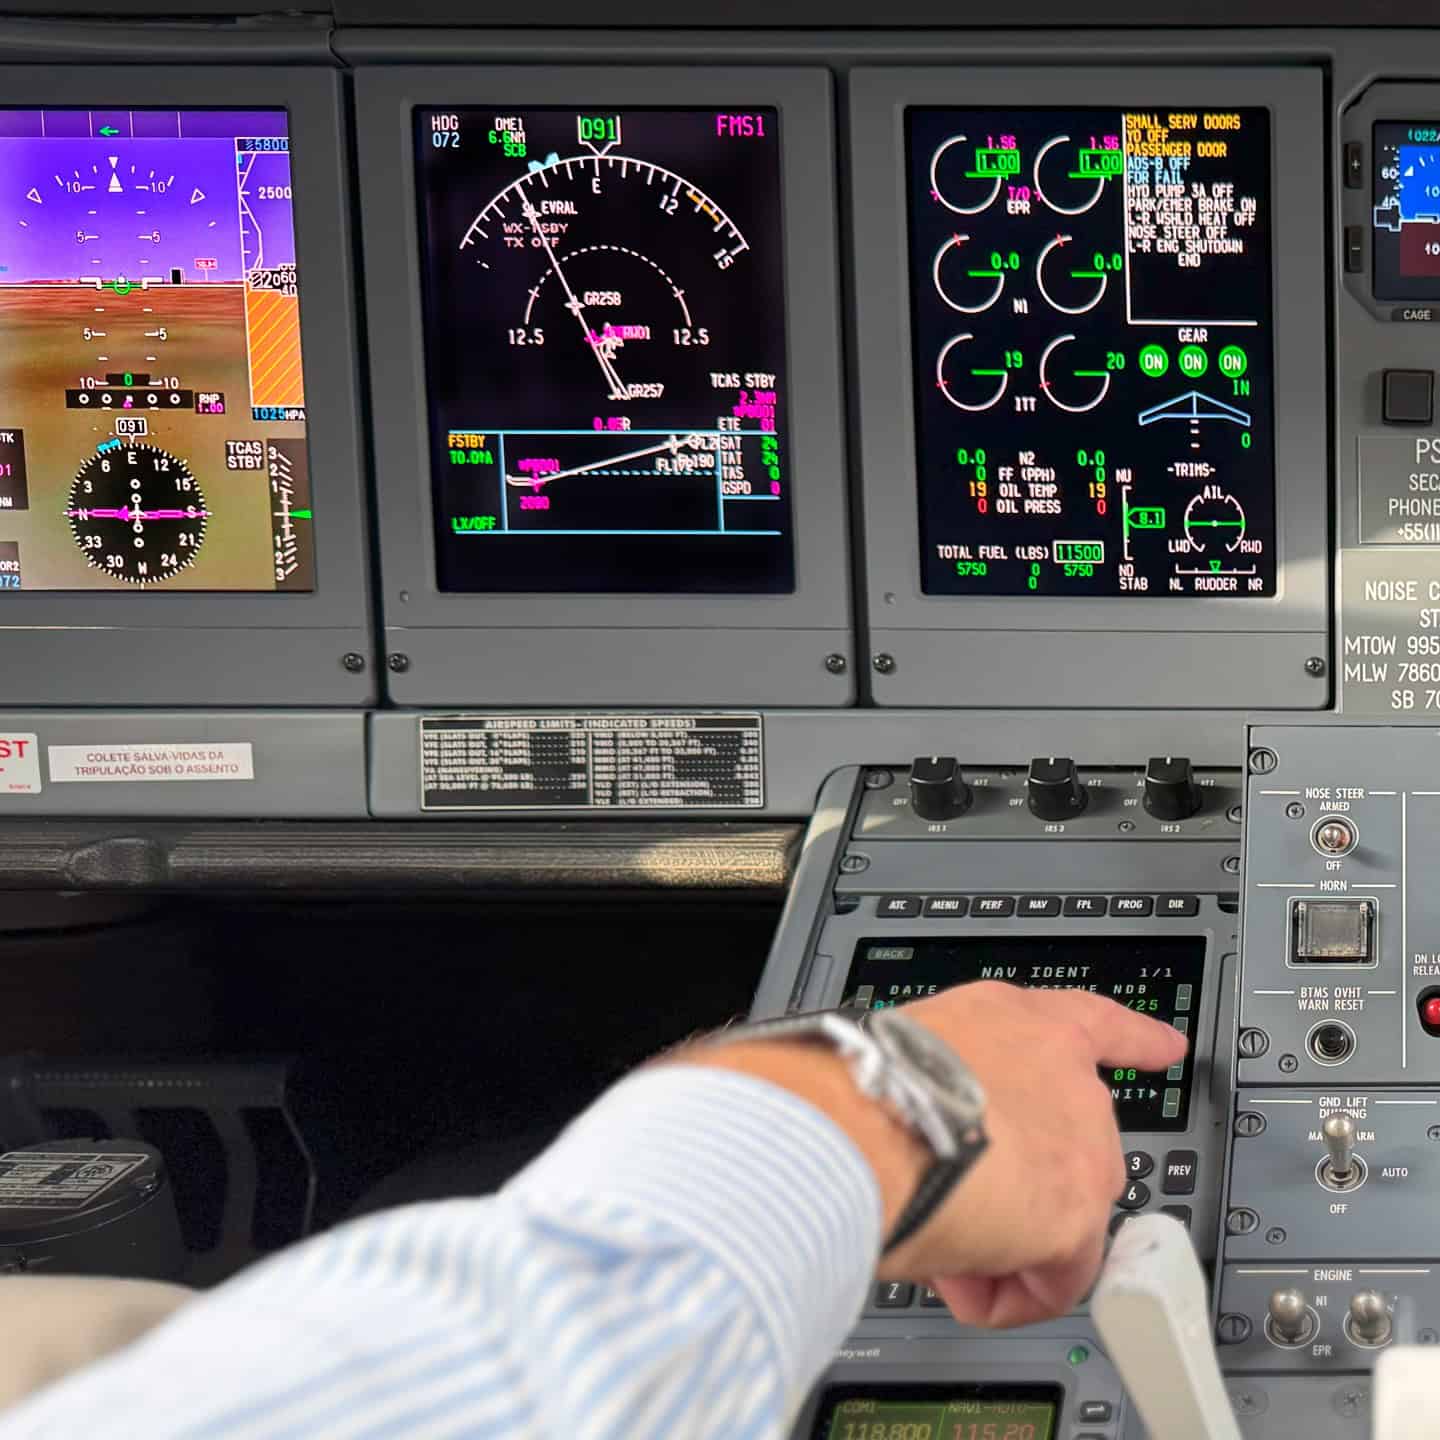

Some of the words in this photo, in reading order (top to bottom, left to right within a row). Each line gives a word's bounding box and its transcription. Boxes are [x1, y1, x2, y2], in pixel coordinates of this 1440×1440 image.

[432, 116, 458, 130] HDG
[717, 116, 765, 136] FMS1
[1127, 115, 1162, 129] SMALL
[1169, 115, 1197, 129] SERV
[1204, 115, 1240, 129] DOORS
[581, 119, 616, 140] 091
[433, 133, 459, 147] 072
[1127, 143, 1191, 156] PASSENGER
[1198, 144, 1227, 157] DOOR
[1128, 199, 1192, 211] PARK/EMER
[1198, 199, 1233, 212] BRAKE
[1241, 199, 1256, 212] ON
[1128, 226, 1157, 238] NOSE
[1164, 227, 1200, 238] STEER
[1206, 227, 1227, 239] OFF
[1404, 310, 1430, 320] CAGE
[1179, 329, 1207, 342] GEAR
[119, 420, 144, 434] 091
[228, 442, 260, 454] TCAS
[228, 456, 262, 468] STBY
[999, 468, 1013, 481] FF
[1022, 468, 1055, 481] (PPH)
[1000, 484, 1021, 498] OIL
[1029, 485, 1057, 497] TEMP
[997, 501, 1017, 514] OIL
[1025, 501, 1061, 513] PRESS
[938, 547, 972, 559] TOTAL
[980, 547, 1007, 559] FUEL
[1016, 547, 1049, 560] (LBS)
[1058, 547, 1101, 560] 11500
[1120, 578, 1148, 590] STAB
[1195, 578, 1237, 590] RUDDER
[1365, 581, 1417, 600] NOISE
[1345, 636, 1396, 655] MTOW
[1345, 664, 1387, 682] MLW
[1391, 690, 1414, 708] SB
[87, 753, 129, 762] COLETE
[134, 752, 205, 762] SALVA-VIDAS
[209, 752, 223, 761] DA
[76, 765, 145, 776] TRIPULAÇÃO
[148, 764, 171, 774] SOB
[175, 764, 183, 774] O
[187, 764, 238, 774] ASSENTO
[1305, 788, 1331, 799] NOSE
[1336, 788, 1364, 799] STEER
[1320, 802, 1349, 811] ARMED
[1326, 861, 1342, 870] OFF
[1320, 880, 1347, 891] HORN
[888, 901, 906, 910] ATC
[931, 900, 959, 910] MENU
[981, 900, 1003, 910] PERF
[1029, 900, 1047, 910] NAV
[1077, 900, 1092, 909] FPL
[1118, 900, 1142, 909] PROG
[1168, 899, 1184, 909] DIR
[1415, 955, 1427, 965] DN
[982, 967, 1017, 978] NAV
[1031, 967, 1090, 978] IDENT
[1140, 968, 1172, 977] 1/1
[891, 984, 936, 995] DATE
[1301, 987, 1328, 998] BTMS
[1334, 987, 1361, 998] OVHT
[1298, 1000, 1329, 1011] WARN
[1334, 1000, 1363, 1011] RESET
[1319, 1097, 1342, 1107] GND
[1347, 1097, 1367, 1107] LIFT
[1382, 1167, 1408, 1177] AUTO
[1330, 1204, 1347, 1214] OFF
[1314, 1269, 1352, 1281] ENGINE
